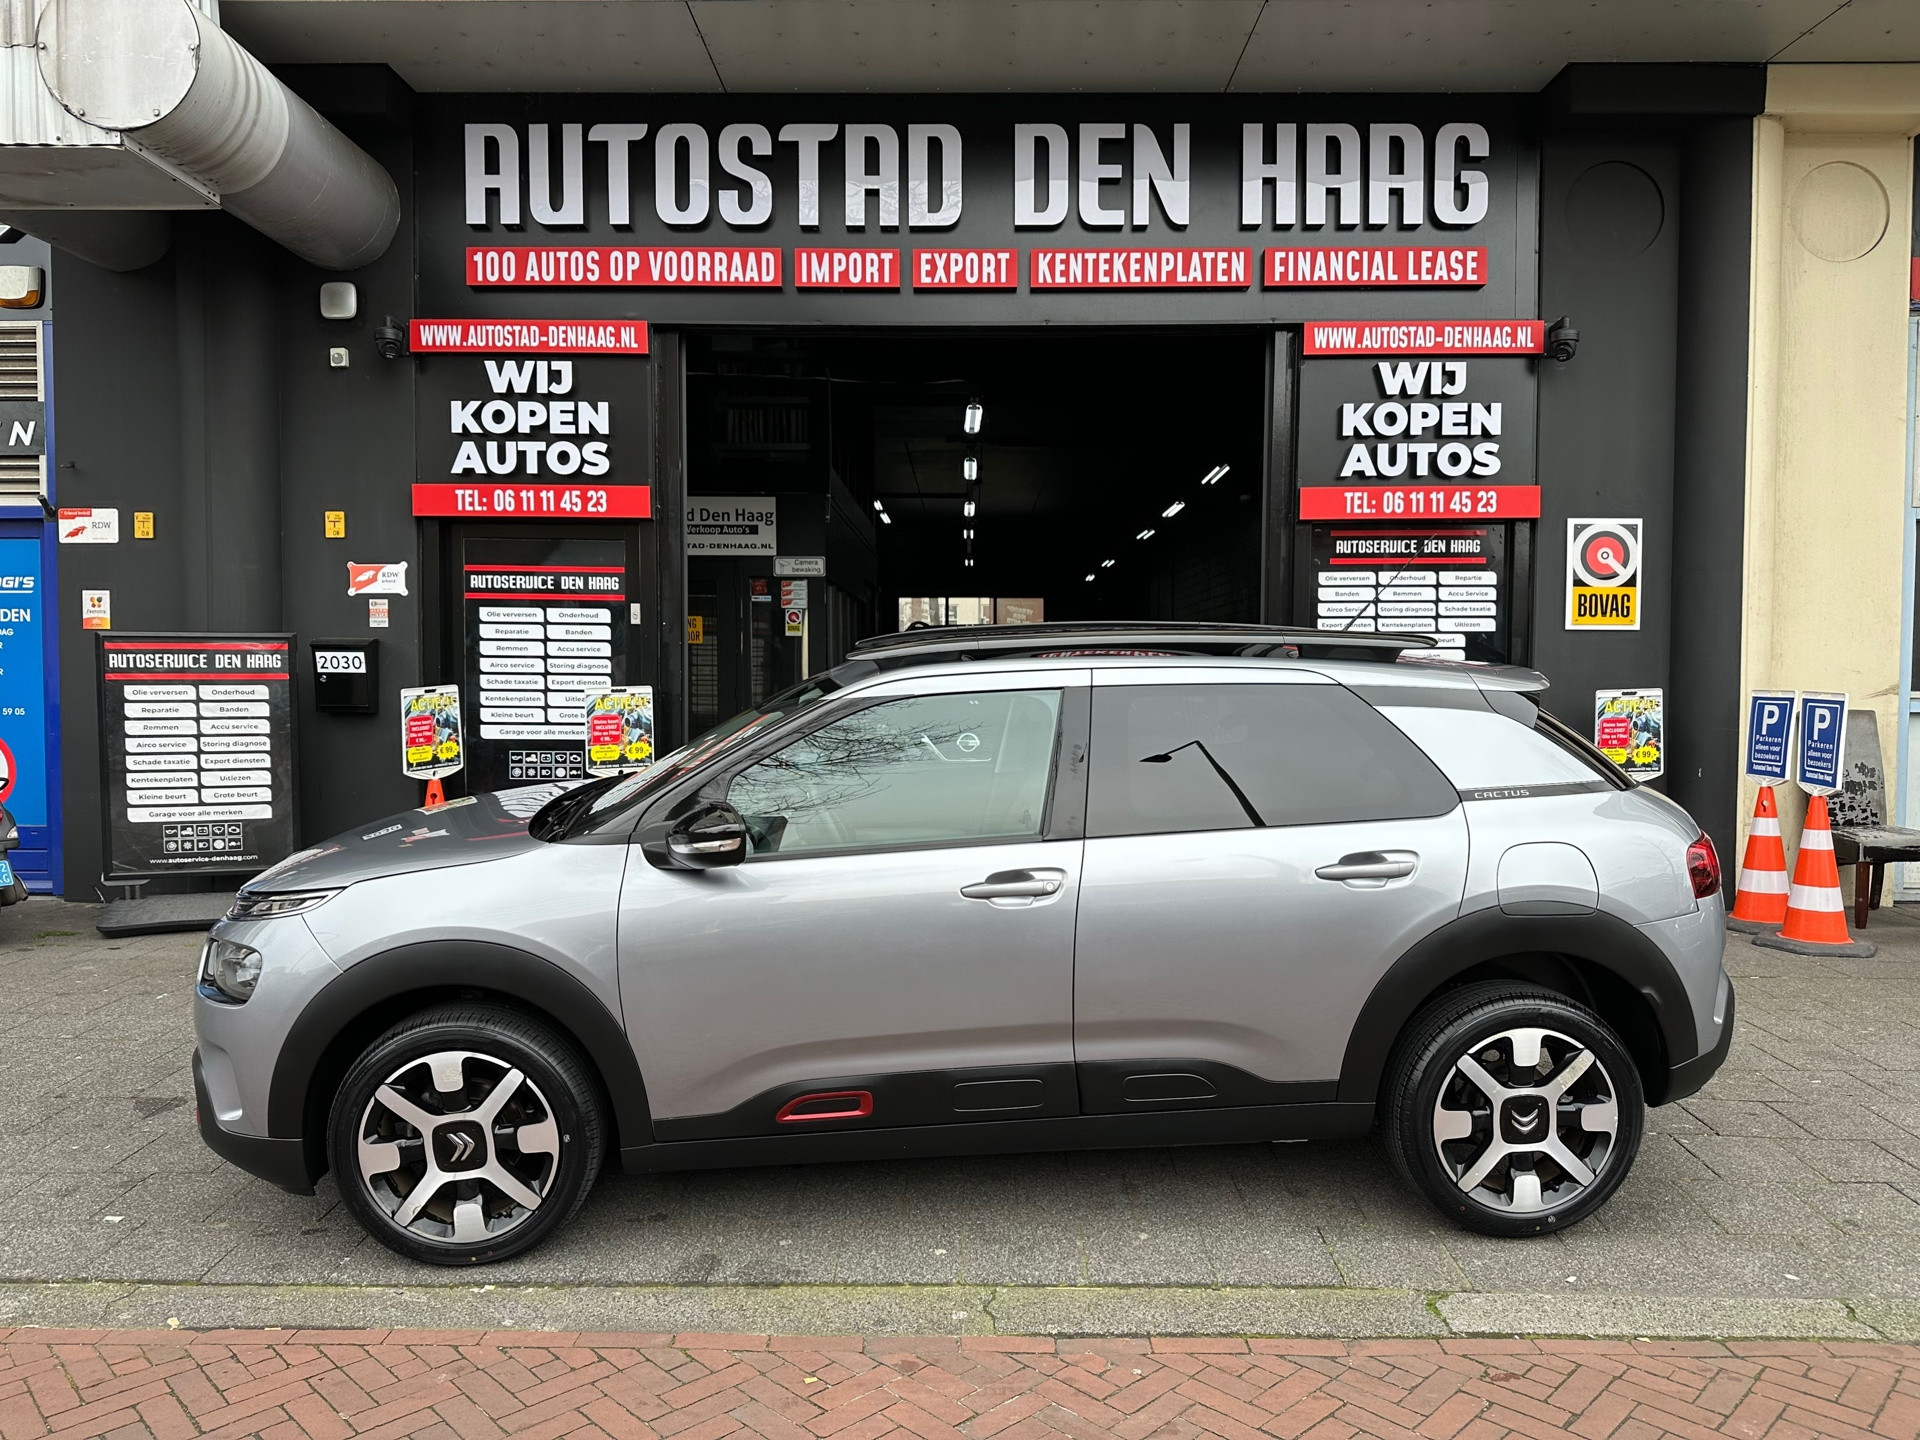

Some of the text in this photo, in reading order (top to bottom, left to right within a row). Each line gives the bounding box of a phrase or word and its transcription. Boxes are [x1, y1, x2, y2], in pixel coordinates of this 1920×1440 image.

[464, 123, 1490, 226] AUTOSTAD DEN HAAG
[473, 250, 776, 283] 100 AUTOS OP VOORRAAD
[801, 252, 893, 283] IMPORT
[921, 252, 1010, 283] EXPORT
[1038, 251, 1245, 283] KENTEKENPLATEN
[1274, 250, 1479, 282] FINANCIAL LEASE
[420, 325, 639, 348] WWW.AUTOSTAD-DENHAAG.NL
[1314, 326, 1534, 349] WWW.AUTOSTAD-DENHAAG.NL
[484, 360, 573, 394] WIJ
[1377, 362, 1467, 395] WIJ
[450, 400, 609, 434] KOPEN
[1342, 402, 1502, 436] KOPEN
[8, 421, 35, 446] N
[450, 441, 610, 476] AUTOS
[1340, 442, 1501, 477] AUTOS
[455, 489, 607, 512] TEL: 06 11 11 45 23
[1344, 490, 1497, 514] TEL: 06 11 11 45 23
[700, 508, 774, 526] Den Haag
[1336, 539, 1481, 554] AUTOSERVICE DEN HAAG
[470, 575, 619, 590] AUTOSERVICE DEN HAAG
[1577, 593, 1630, 618] BOVAG
[495, 628, 529, 636] Reparatie
[108, 653, 282, 669] AUTOSERVICE DEN HAAG
[318, 655, 362, 670] 2030
[411, 697, 441, 711] ACTIE
[595, 697, 632, 710] ACTIE
[1604, 700, 1640, 713] ACTIE
[1761, 704, 1779, 735] P
[1813, 708, 1831, 741] P
[202, 740, 267, 748] Storing diagnose
[1755, 743, 1781, 752] alleen voor
[1756, 735, 1782, 744] Parkeren
[1808, 740, 1833, 750] Parkeren
[1754, 752, 1780, 761] bezoekers
[1807, 758, 1832, 768] bezoekers
[1808, 749, 1832, 759] alleen voor
[131, 776, 193, 784] Kentekenplaten
[1475, 789, 1530, 799] CACTUS
[150, 854, 258, 865] www.autoservice-denhaag.com
